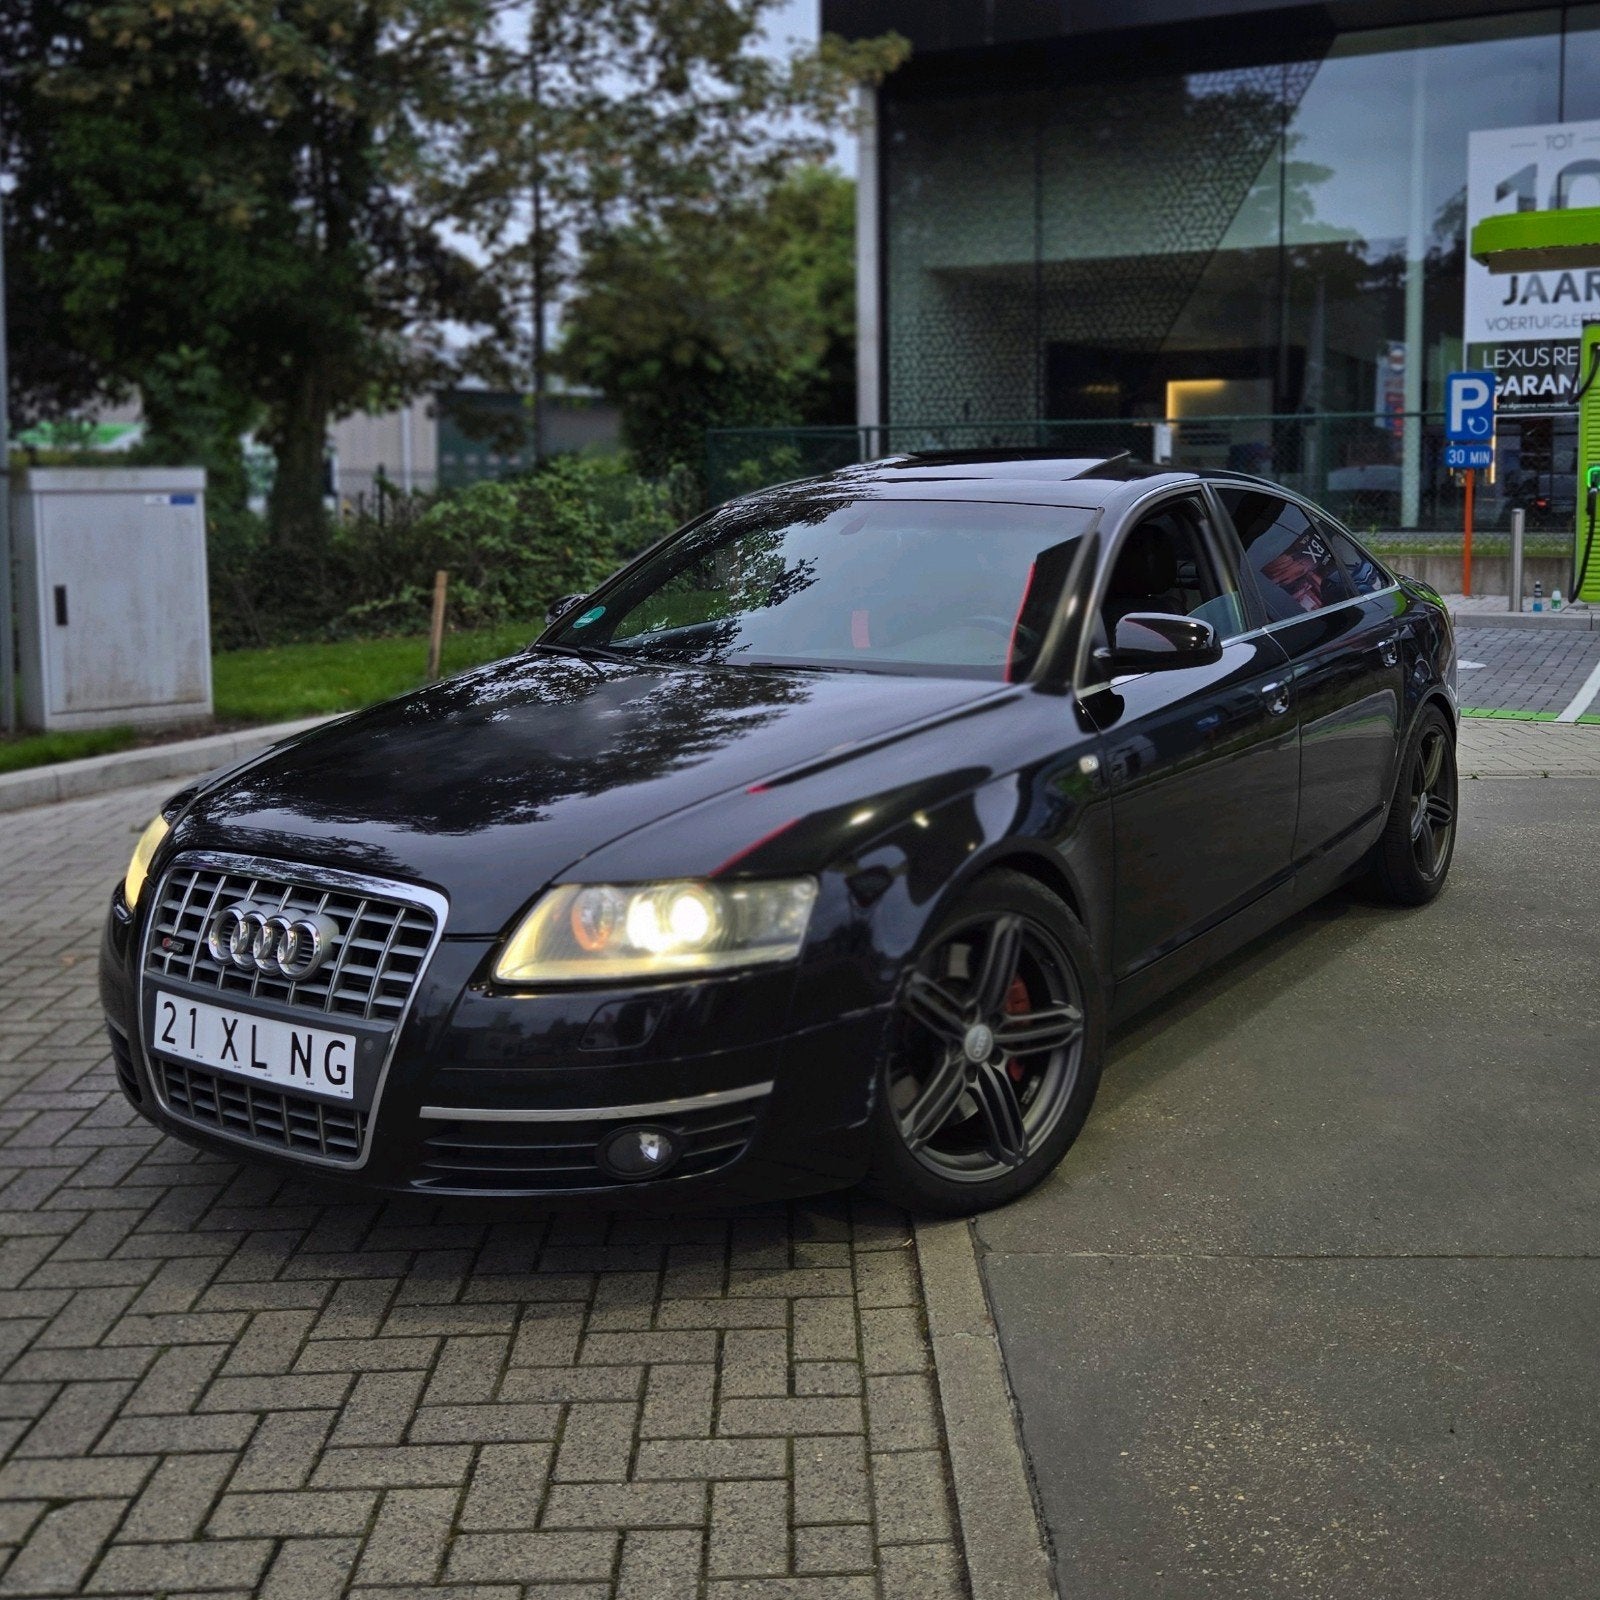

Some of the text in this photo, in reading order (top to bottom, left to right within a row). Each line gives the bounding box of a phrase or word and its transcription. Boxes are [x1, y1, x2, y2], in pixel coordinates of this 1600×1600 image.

[1545, 133, 1575, 150] TOT
[1483, 347, 1550, 368] LEXUS
[1451, 378, 1490, 432] P
[1448, 449, 1490, 465] 30 MIN
[161, 1001, 347, 1086] 21 XL NG
